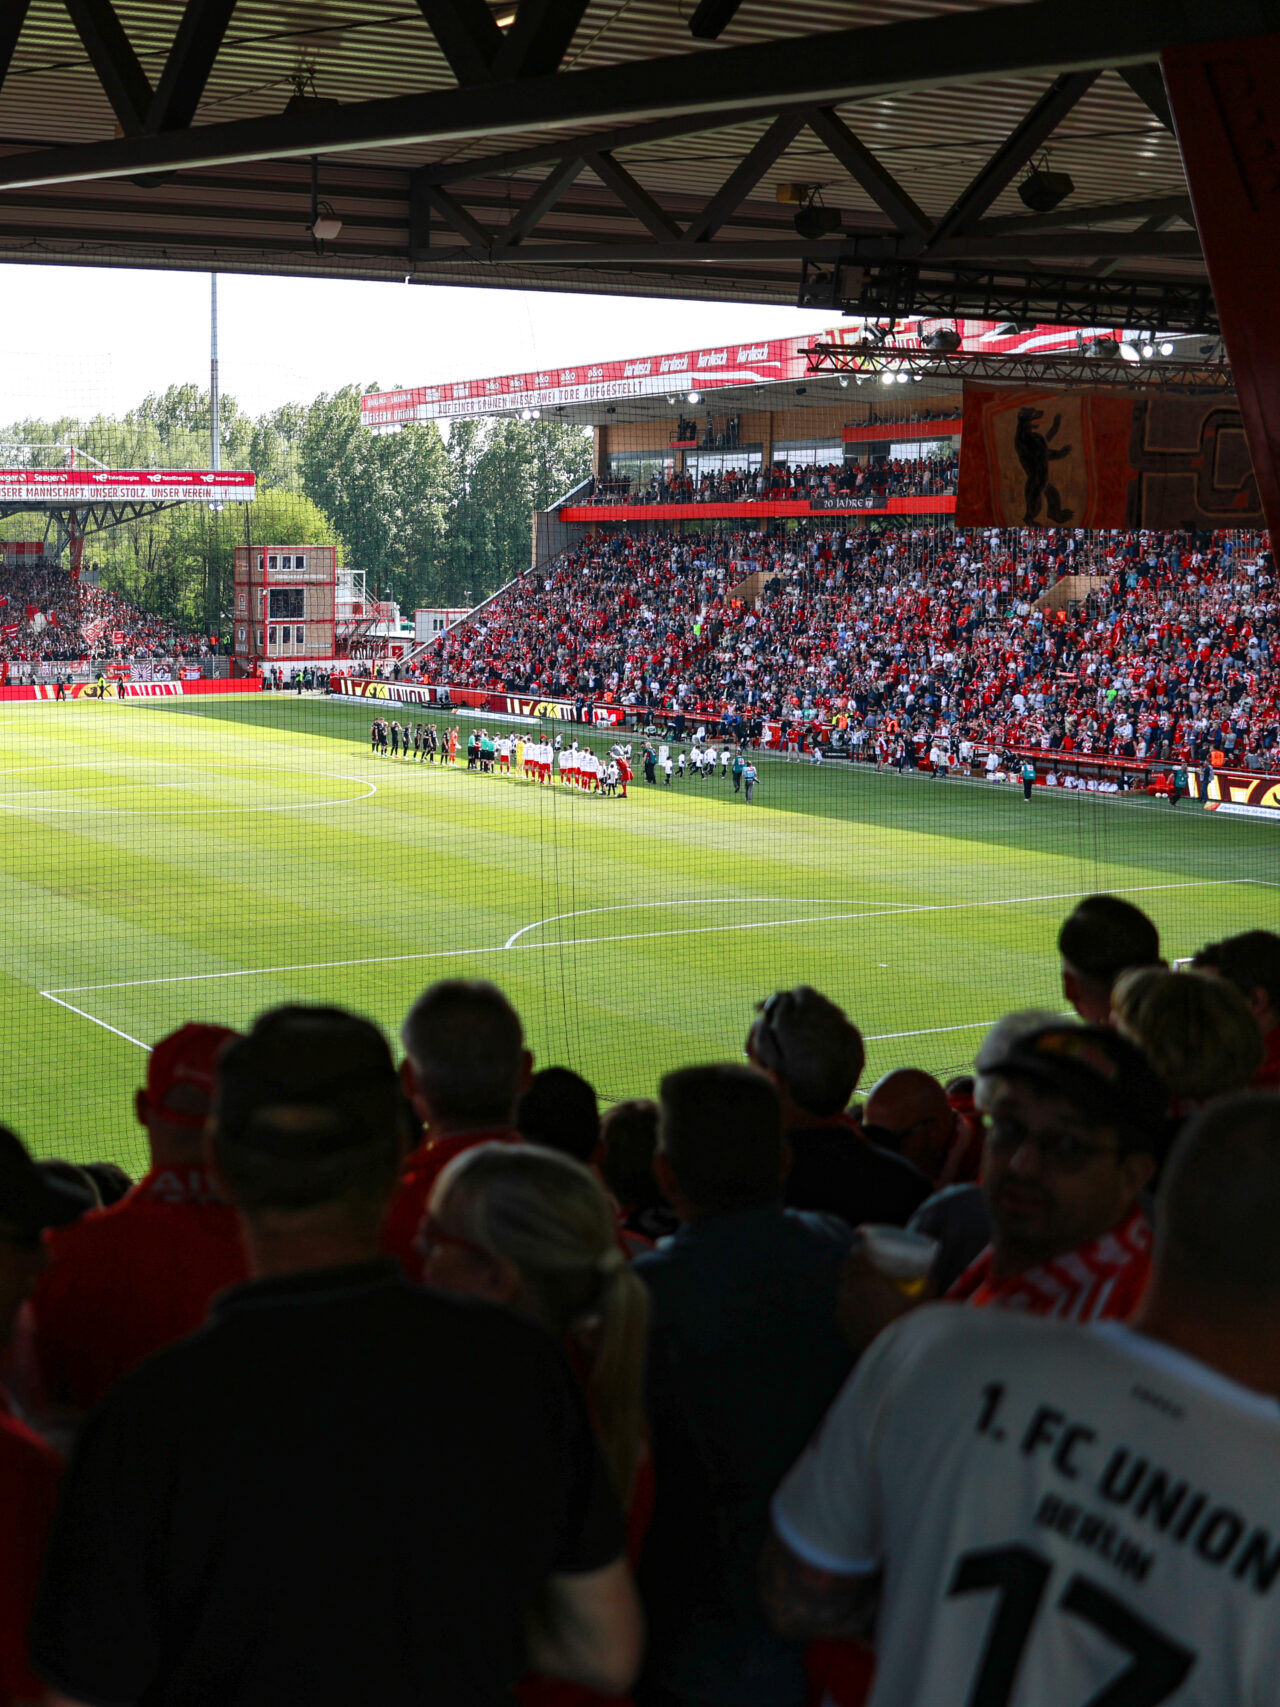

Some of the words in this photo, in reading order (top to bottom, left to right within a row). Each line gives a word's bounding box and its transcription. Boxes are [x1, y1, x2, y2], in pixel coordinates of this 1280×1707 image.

[559, 387, 580, 400] TORE
[584, 380, 644, 398] AUFGESTELLT
[33, 473, 60, 482] Seeger
[26, 487, 86, 497] MANNSCHAFT.
[90, 488, 118, 497] UNSER
[120, 488, 148, 497] STOLZ.
[151, 488, 179, 497] UNSER
[182, 488, 214, 497] VEREIN.
[824, 500, 834, 508] 20
[836, 498, 863, 508] JAHRE
[387, 687, 429, 703] UNION
[973, 1381, 1007, 1443] 1.
[1020, 1402, 1097, 1480] FC
[1100, 1446, 1280, 1595] UNION
[1033, 1491, 1157, 1585] BERLIN
[946, 1540, 1198, 1707] 17
